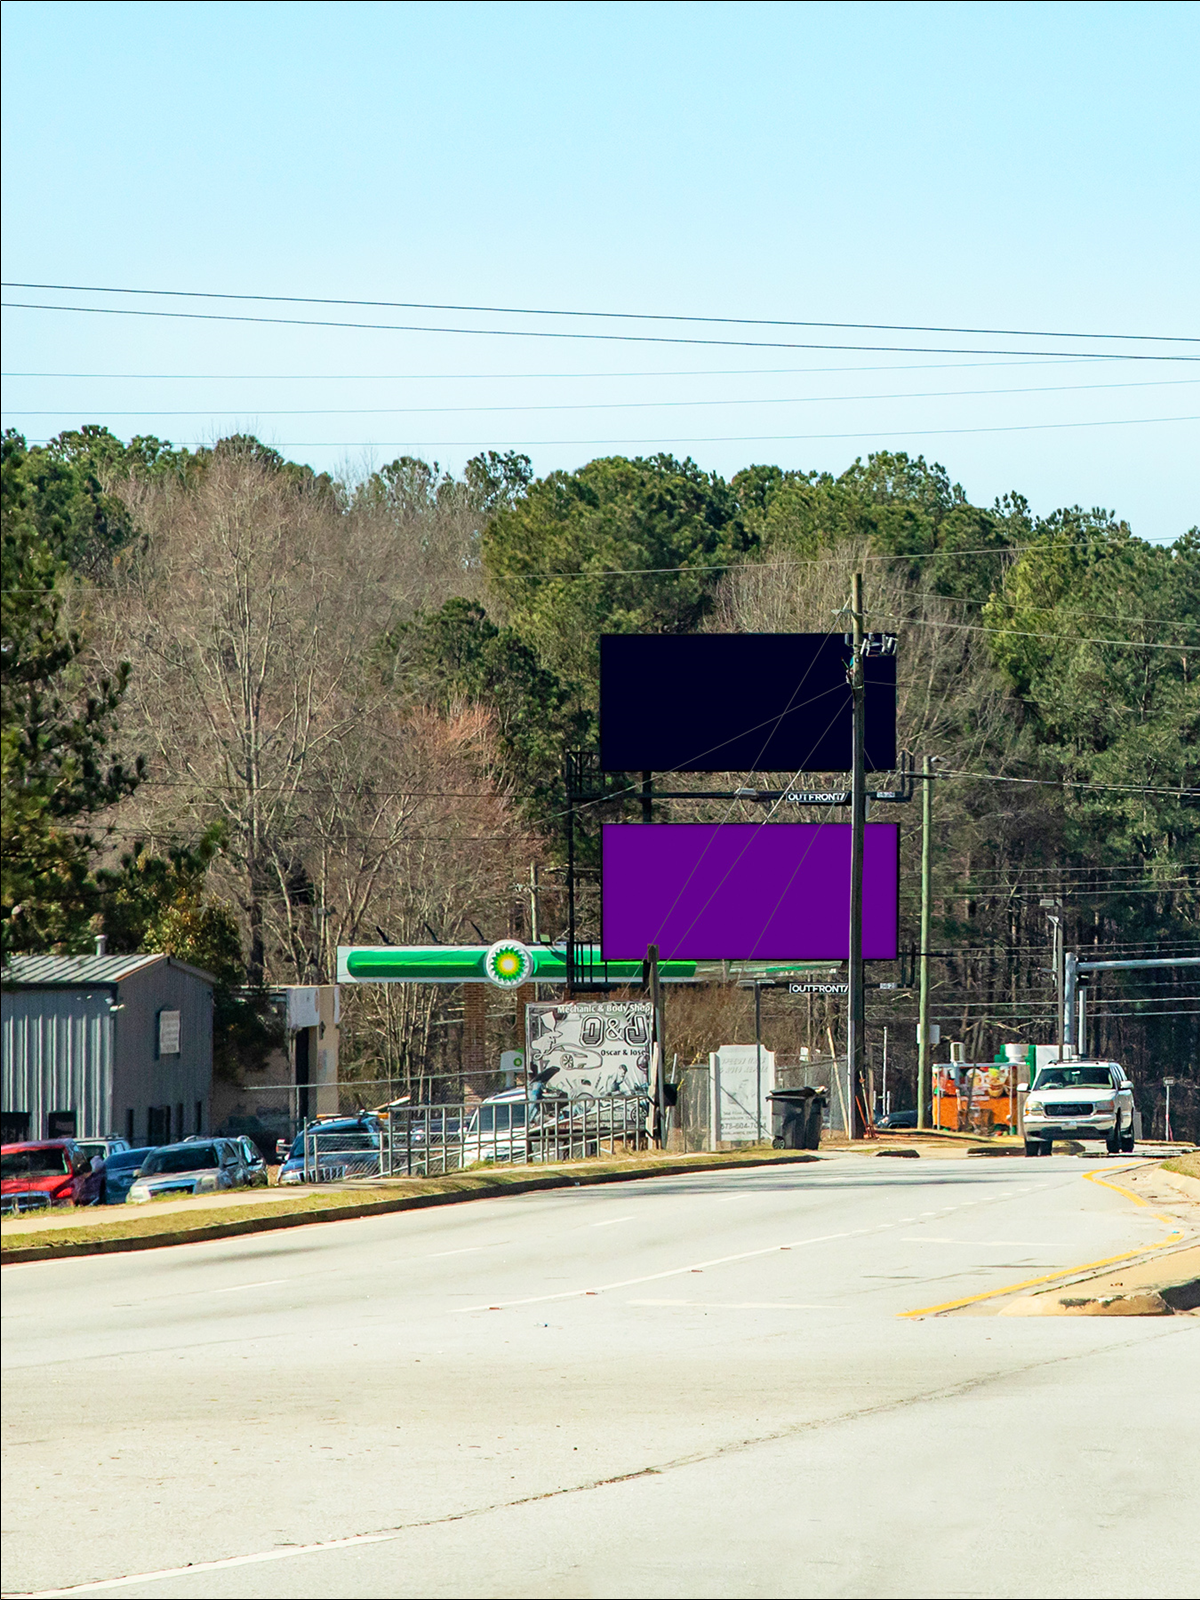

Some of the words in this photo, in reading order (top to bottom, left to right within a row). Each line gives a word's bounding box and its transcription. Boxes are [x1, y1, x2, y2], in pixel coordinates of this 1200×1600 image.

[557, 1005, 596, 1014] Mechanic
[597, 1005, 604, 1013] &
[606, 1004, 627, 1014] Body
[629, 1003, 651, 1015] Shop
[580, 1015, 604, 1048] O
[606, 1017, 624, 1041] &
[624, 1014, 649, 1048] J
